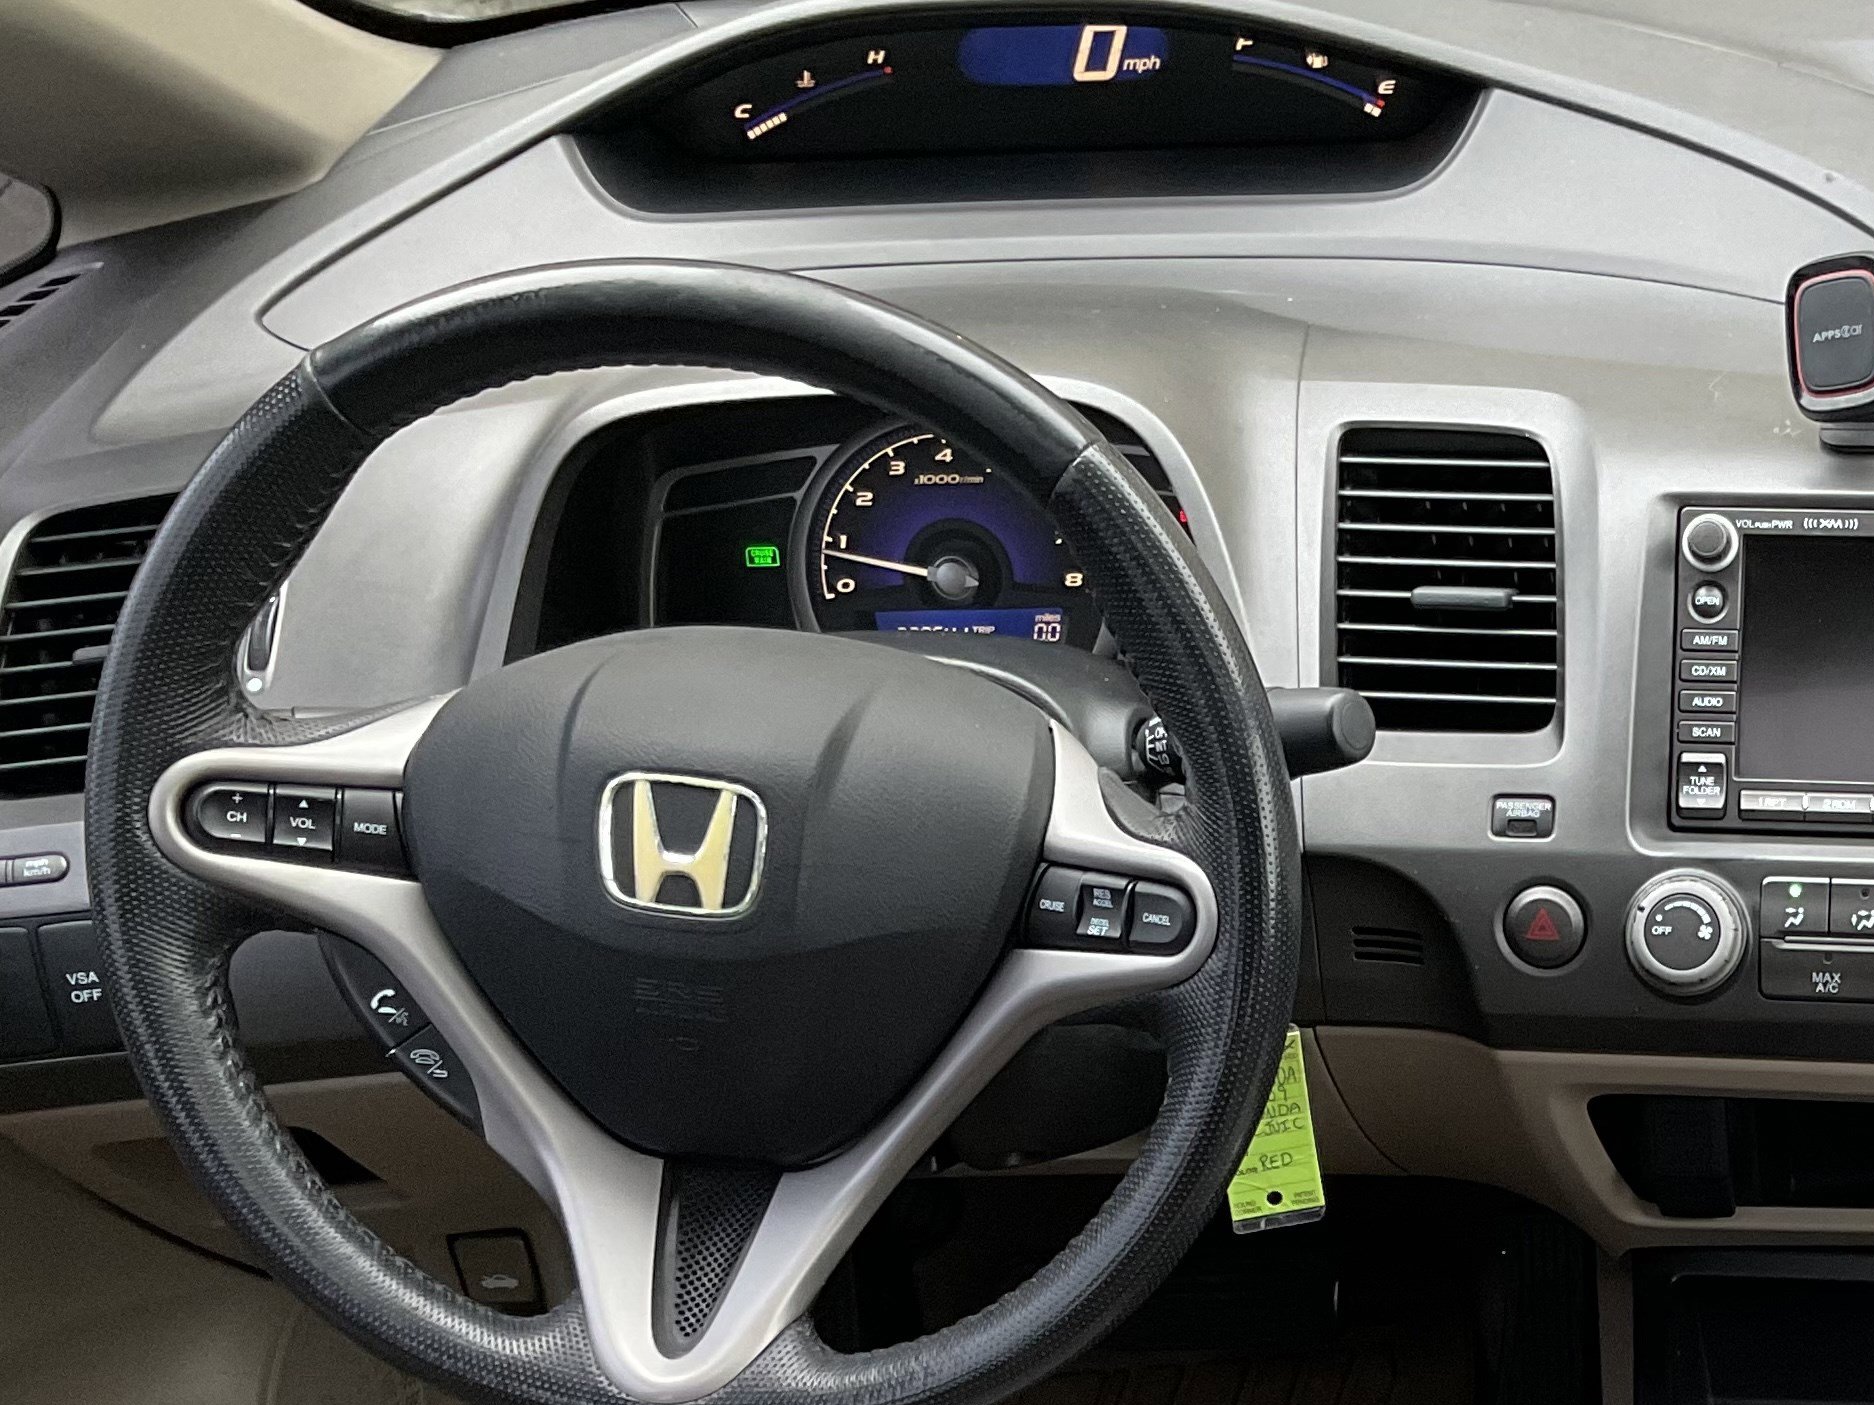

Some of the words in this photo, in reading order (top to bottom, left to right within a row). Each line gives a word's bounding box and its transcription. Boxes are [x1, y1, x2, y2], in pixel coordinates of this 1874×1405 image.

[866, 50, 886, 65] H
[1073, 25, 1128, 82] 0
[1122, 55, 1161, 74] mph
[1377, 79, 1397, 95] E
[734, 103, 753, 118] C
[934, 448, 954, 463] 4
[888, 460, 906, 476] 3
[855, 491, 874, 507] 2
[1735, 519, 1755, 529] VOL
[1771, 519, 1794, 529] PWR
[839, 534, 848, 549] 1
[836, 578, 856, 593] 0
[1064, 571, 1084, 587] 8
[1694, 596, 1720, 606] OPEN
[1692, 635, 1728, 646] AM/FM
[1691, 665, 1726, 676] CD/XM
[1691, 697, 1723, 707] AUDIO
[1692, 727, 1721, 738] SCAN
[1689, 776, 1715, 786] TUNE
[1682, 785, 1721, 795] FOLDER
[1496, 801, 1552, 811] PASSENGER
[226, 810, 247, 823] CH
[1506, 809, 1540, 818] AIRBAG
[289, 816, 316, 830] VOL
[353, 822, 388, 836] MODE
[23, 866, 51, 877] km/h
[1039, 899, 1065, 912] CRUISE
[1142, 912, 1171, 926] CANCEL
[1086, 925, 1109, 936] SET
[1651, 926, 1673, 936] OFF
[65, 971, 100, 985] VSA
[1811, 971, 1842, 984] MAX
[1815, 982, 1840, 993] A/C
[70, 988, 102, 1003] OFF
[1259, 1151, 1293, 1173] RED
